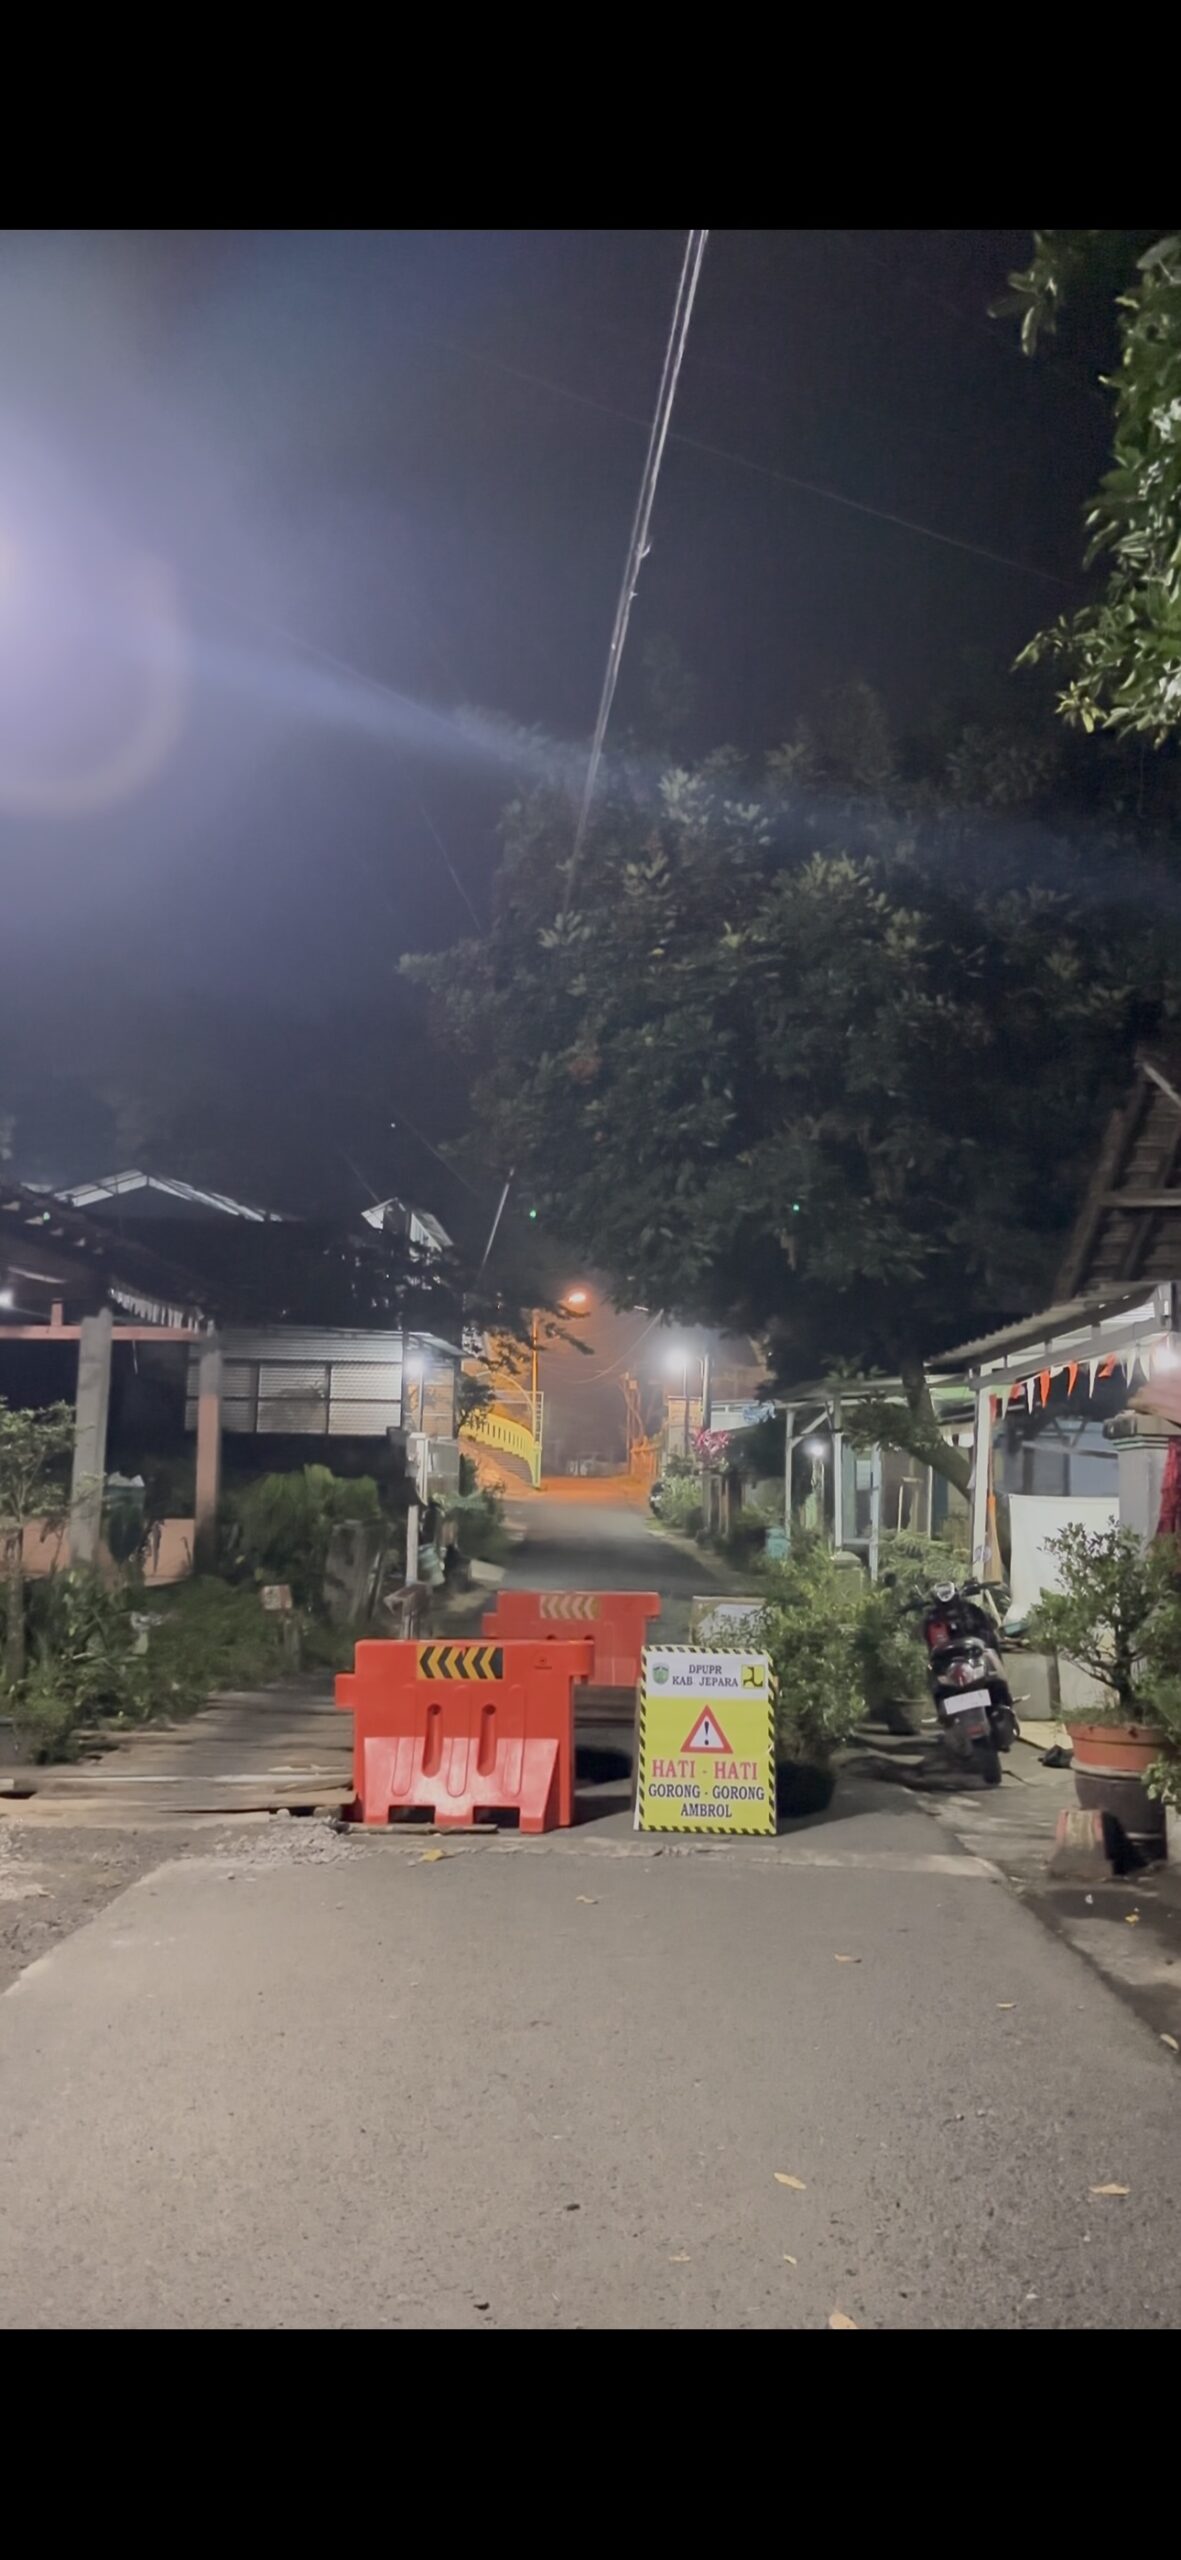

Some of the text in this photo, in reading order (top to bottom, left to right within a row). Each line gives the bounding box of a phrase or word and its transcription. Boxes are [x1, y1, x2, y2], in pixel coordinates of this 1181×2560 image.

[688, 1664, 722, 1674] DPUPR
[672, 1676, 739, 1687] KAB JEPARA
[652, 1759, 695, 1778] HATI
[714, 1761, 757, 1780] HATI
[648, 1783, 700, 1798] GORONG
[712, 1785, 765, 1800] GORONG
[680, 1803, 732, 1818] AMBROL
